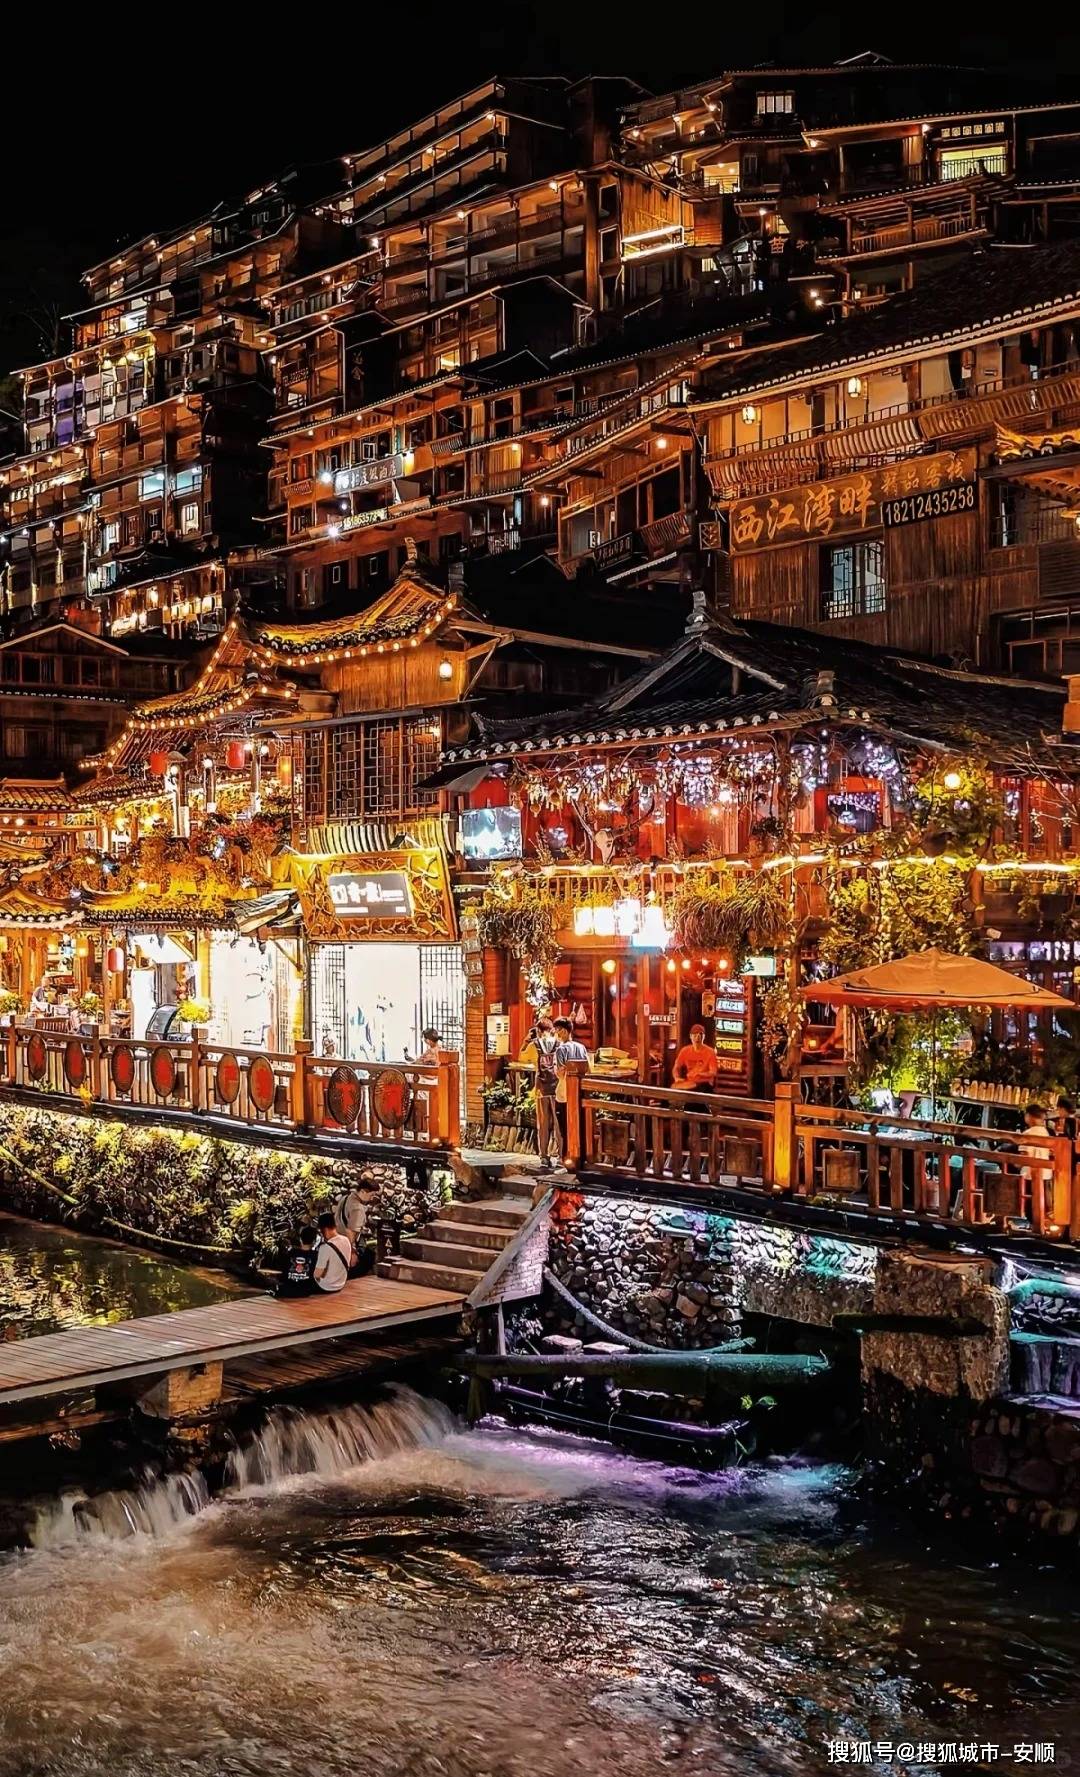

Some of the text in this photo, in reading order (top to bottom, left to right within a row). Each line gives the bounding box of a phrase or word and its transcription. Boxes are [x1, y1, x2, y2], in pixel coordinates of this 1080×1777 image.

[733, 458, 966, 543] 西江湾畔 精品客栈
[885, 485, 974, 526] 18212435258
